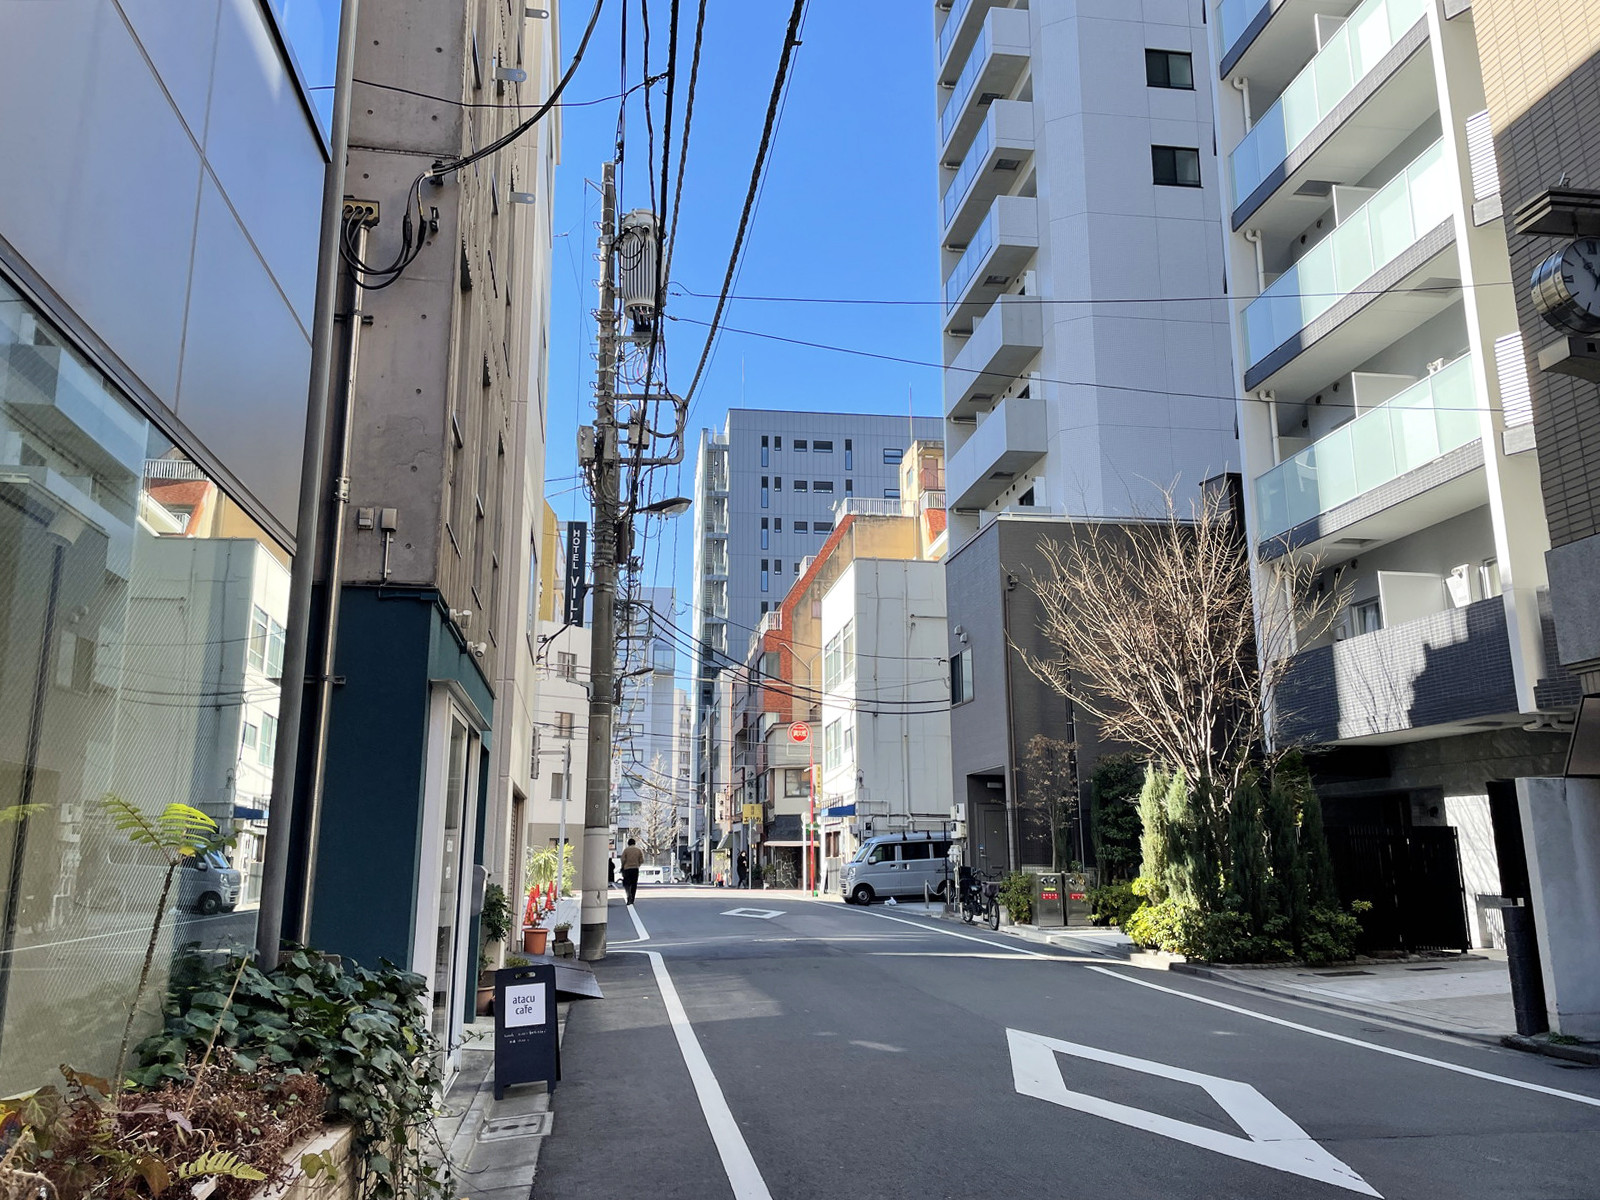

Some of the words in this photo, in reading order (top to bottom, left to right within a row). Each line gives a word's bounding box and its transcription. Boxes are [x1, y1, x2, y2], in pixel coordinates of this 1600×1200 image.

[572, 530, 581, 569] HOTEL
[512, 995, 536, 1004] atacu
[515, 1004, 533, 1015] cafe
